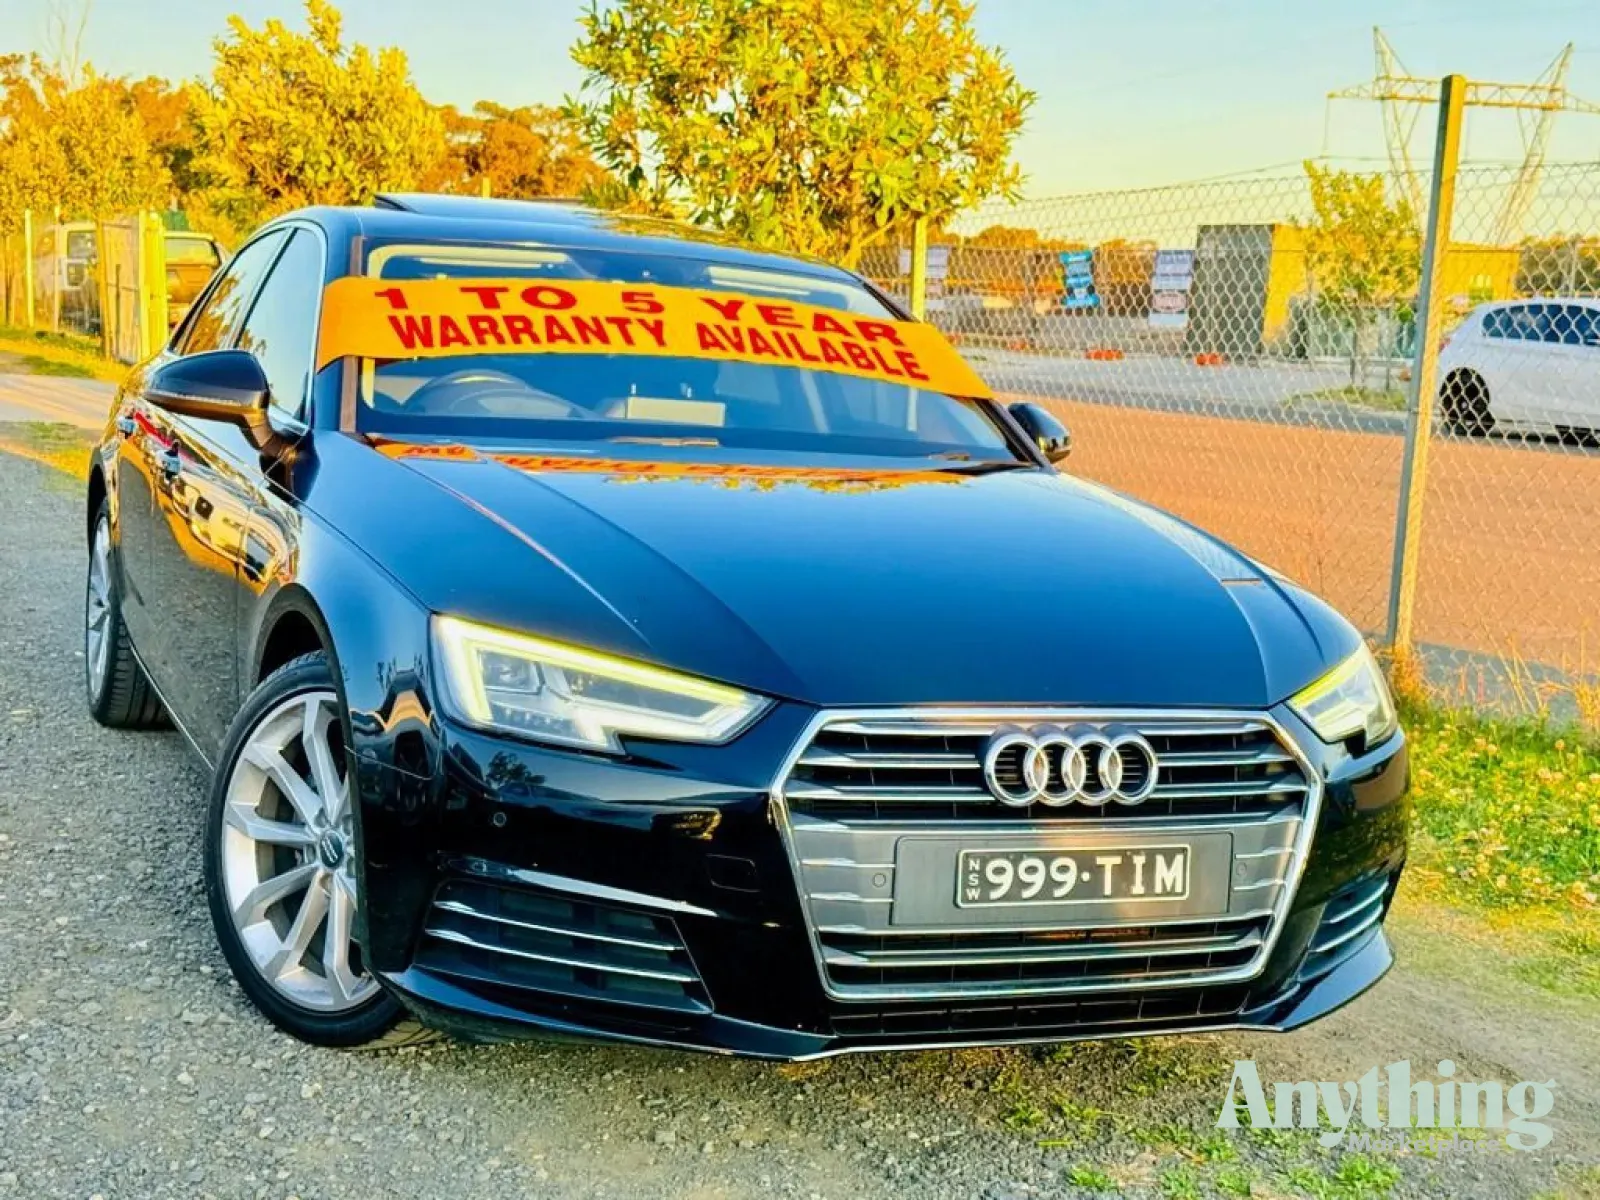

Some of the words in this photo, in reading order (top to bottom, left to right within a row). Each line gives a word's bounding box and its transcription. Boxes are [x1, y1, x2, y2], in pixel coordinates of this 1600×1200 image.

[373, 287, 408, 310] 1
[460, 286, 577, 310] TO
[621, 290, 665, 314] 5
[703, 297, 905, 347] YEAR
[388, 315, 666, 349] WARRANTY
[696, 323, 930, 381] AVAILABLE
